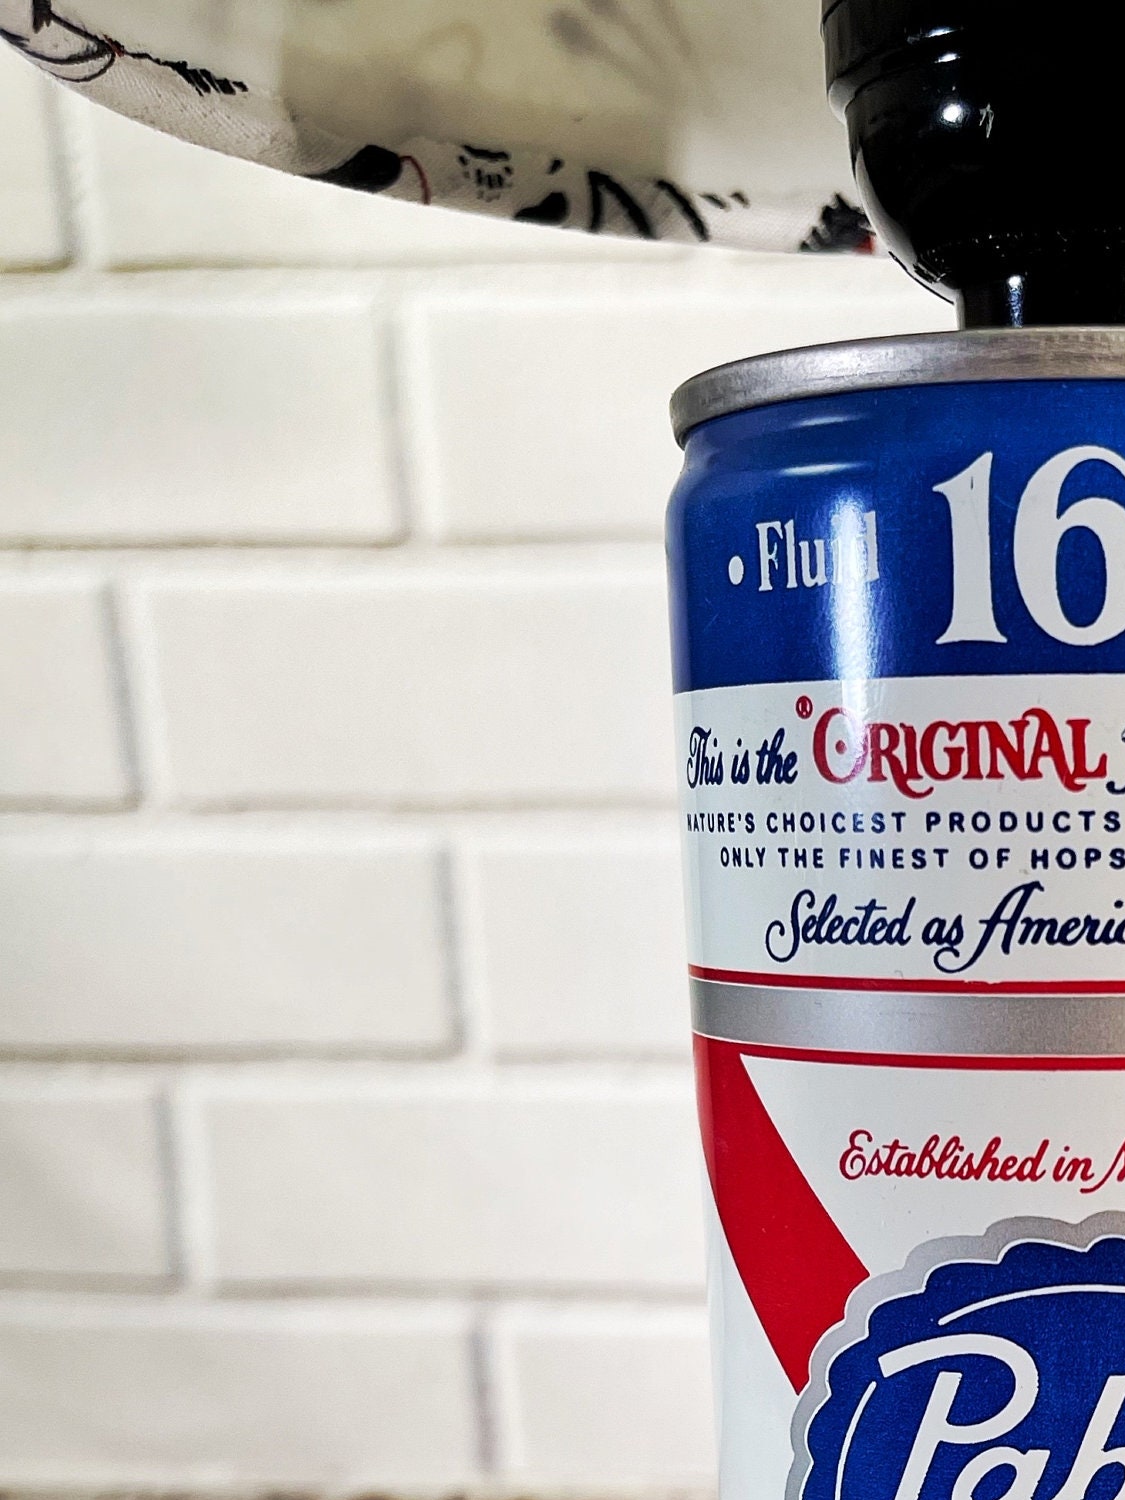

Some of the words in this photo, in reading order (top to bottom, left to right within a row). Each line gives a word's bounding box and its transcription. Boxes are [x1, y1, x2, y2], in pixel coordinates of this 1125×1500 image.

[686, 726, 724, 789] This
[730, 738, 750, 785] is
[755, 727, 799, 785] the
[812, 706, 1107, 800] ORIGINAL
[687, 812, 756, 834] NATURE'S
[766, 811, 907, 834] CHOICEST
[926, 810, 1121, 834] PRODUCTS
[720, 845, 766, 869] ONLY
[778, 846, 824, 869] THE
[839, 847, 949, 870] FINEST
[968, 848, 1011, 870] OF
[765, 888, 914, 963] Selected
[921, 913, 965, 947] as
[839, 1129, 1050, 1182] Established
[1053, 1145, 1095, 1182] in
